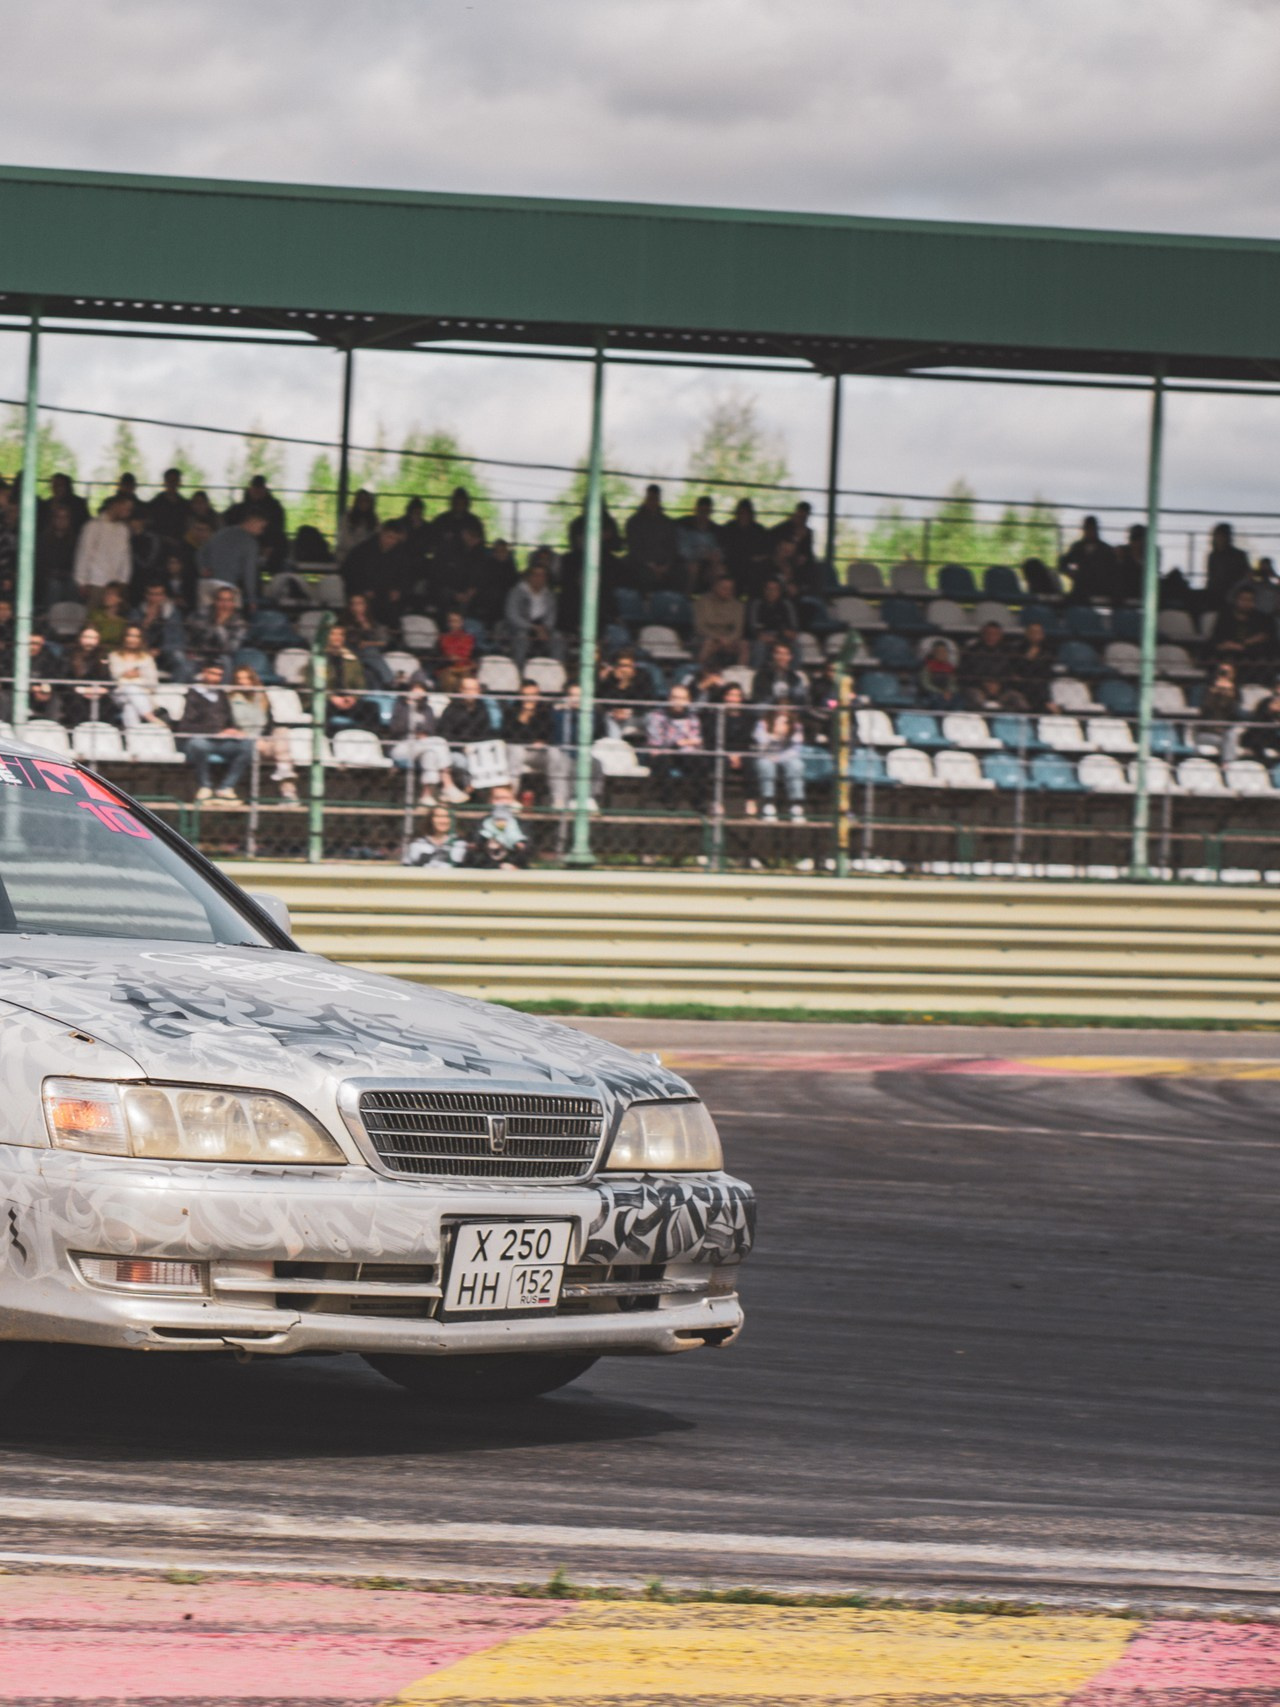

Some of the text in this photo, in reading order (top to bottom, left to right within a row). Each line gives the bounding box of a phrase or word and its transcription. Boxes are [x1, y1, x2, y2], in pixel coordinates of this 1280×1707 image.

[76, 801, 153, 841] 10
[499, 1227, 552, 1261] 250
[516, 1269, 554, 1295] 152
[520, 1295, 538, 1304] RUS
